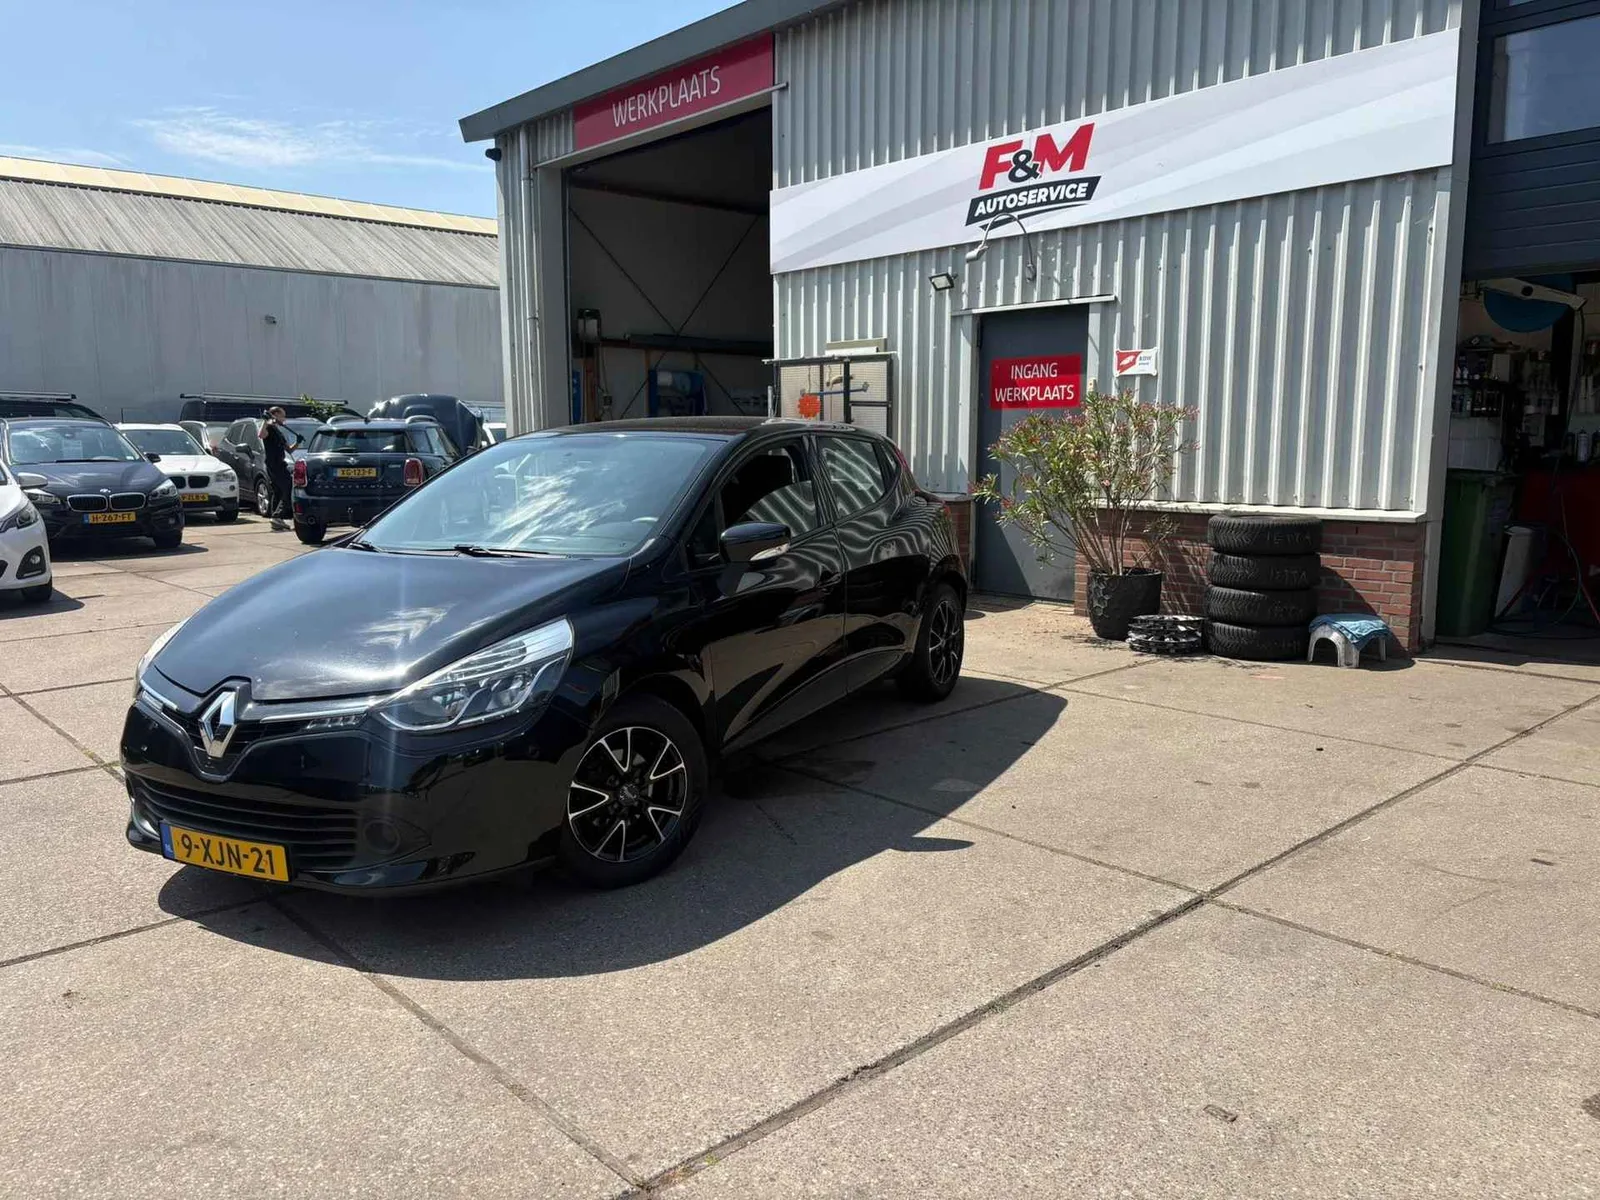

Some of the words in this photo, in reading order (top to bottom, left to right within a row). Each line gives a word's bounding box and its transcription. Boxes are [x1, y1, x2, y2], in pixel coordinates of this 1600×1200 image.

[612, 65, 721, 128] WERKPLAATS
[979, 122, 1095, 190] F&M
[974, 182, 1089, 217] AUTOSERVICE
[1010, 362, 1058, 380] INGANG
[994, 384, 1075, 403] WERKPLAATS
[91, 512, 132, 522] H-267-FT
[180, 833, 276, 875] 9-XJN-21
